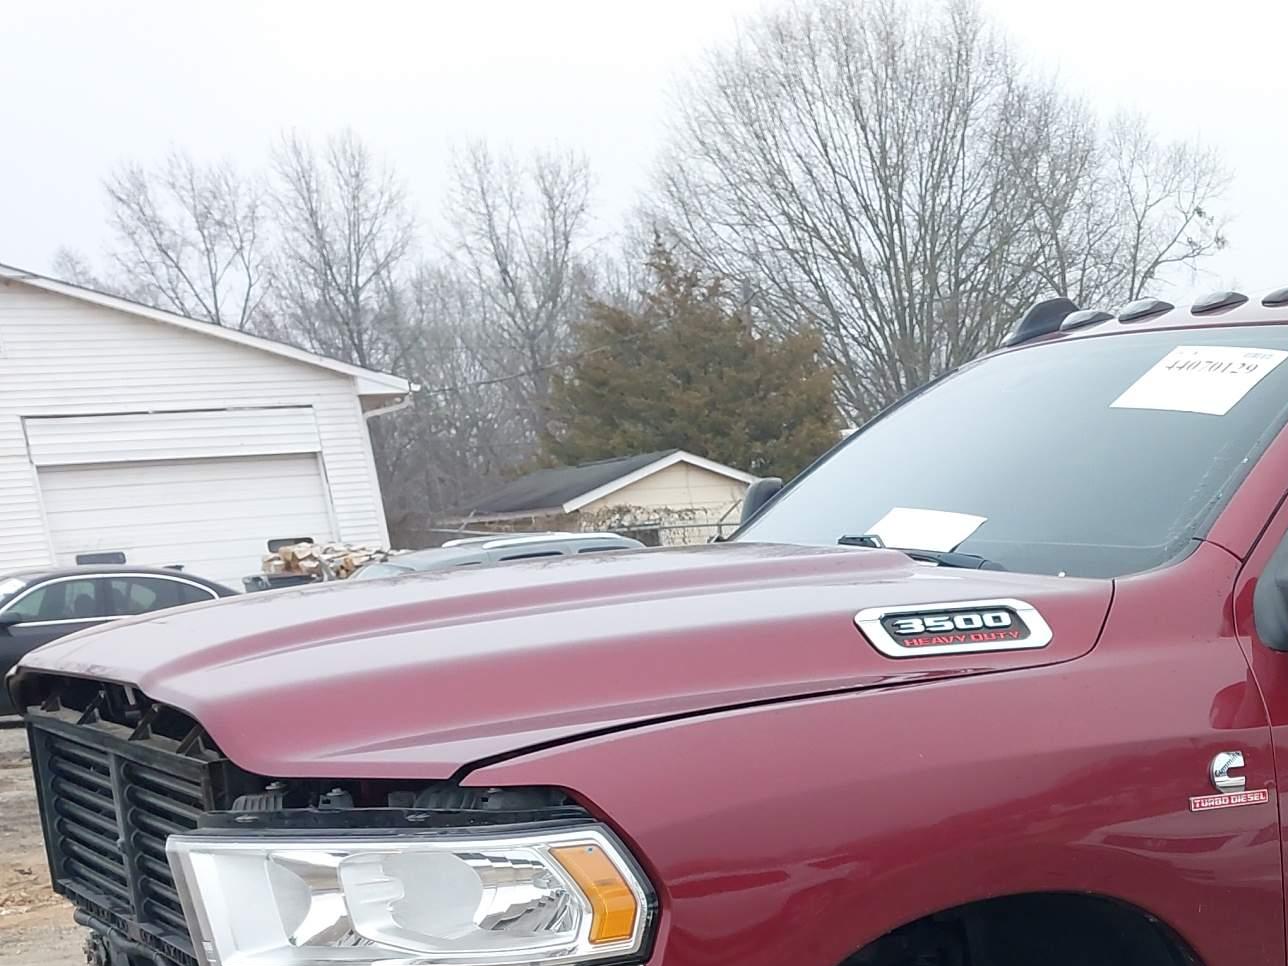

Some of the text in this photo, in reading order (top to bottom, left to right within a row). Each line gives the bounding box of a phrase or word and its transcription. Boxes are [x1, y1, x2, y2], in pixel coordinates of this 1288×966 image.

[1164, 360, 1260, 376] 44070129
[891, 611, 1012, 635] 3500
[903, 630, 1021, 647] HEAVY DUTY
[1193, 792, 1267, 809] TURBO DIESEL
